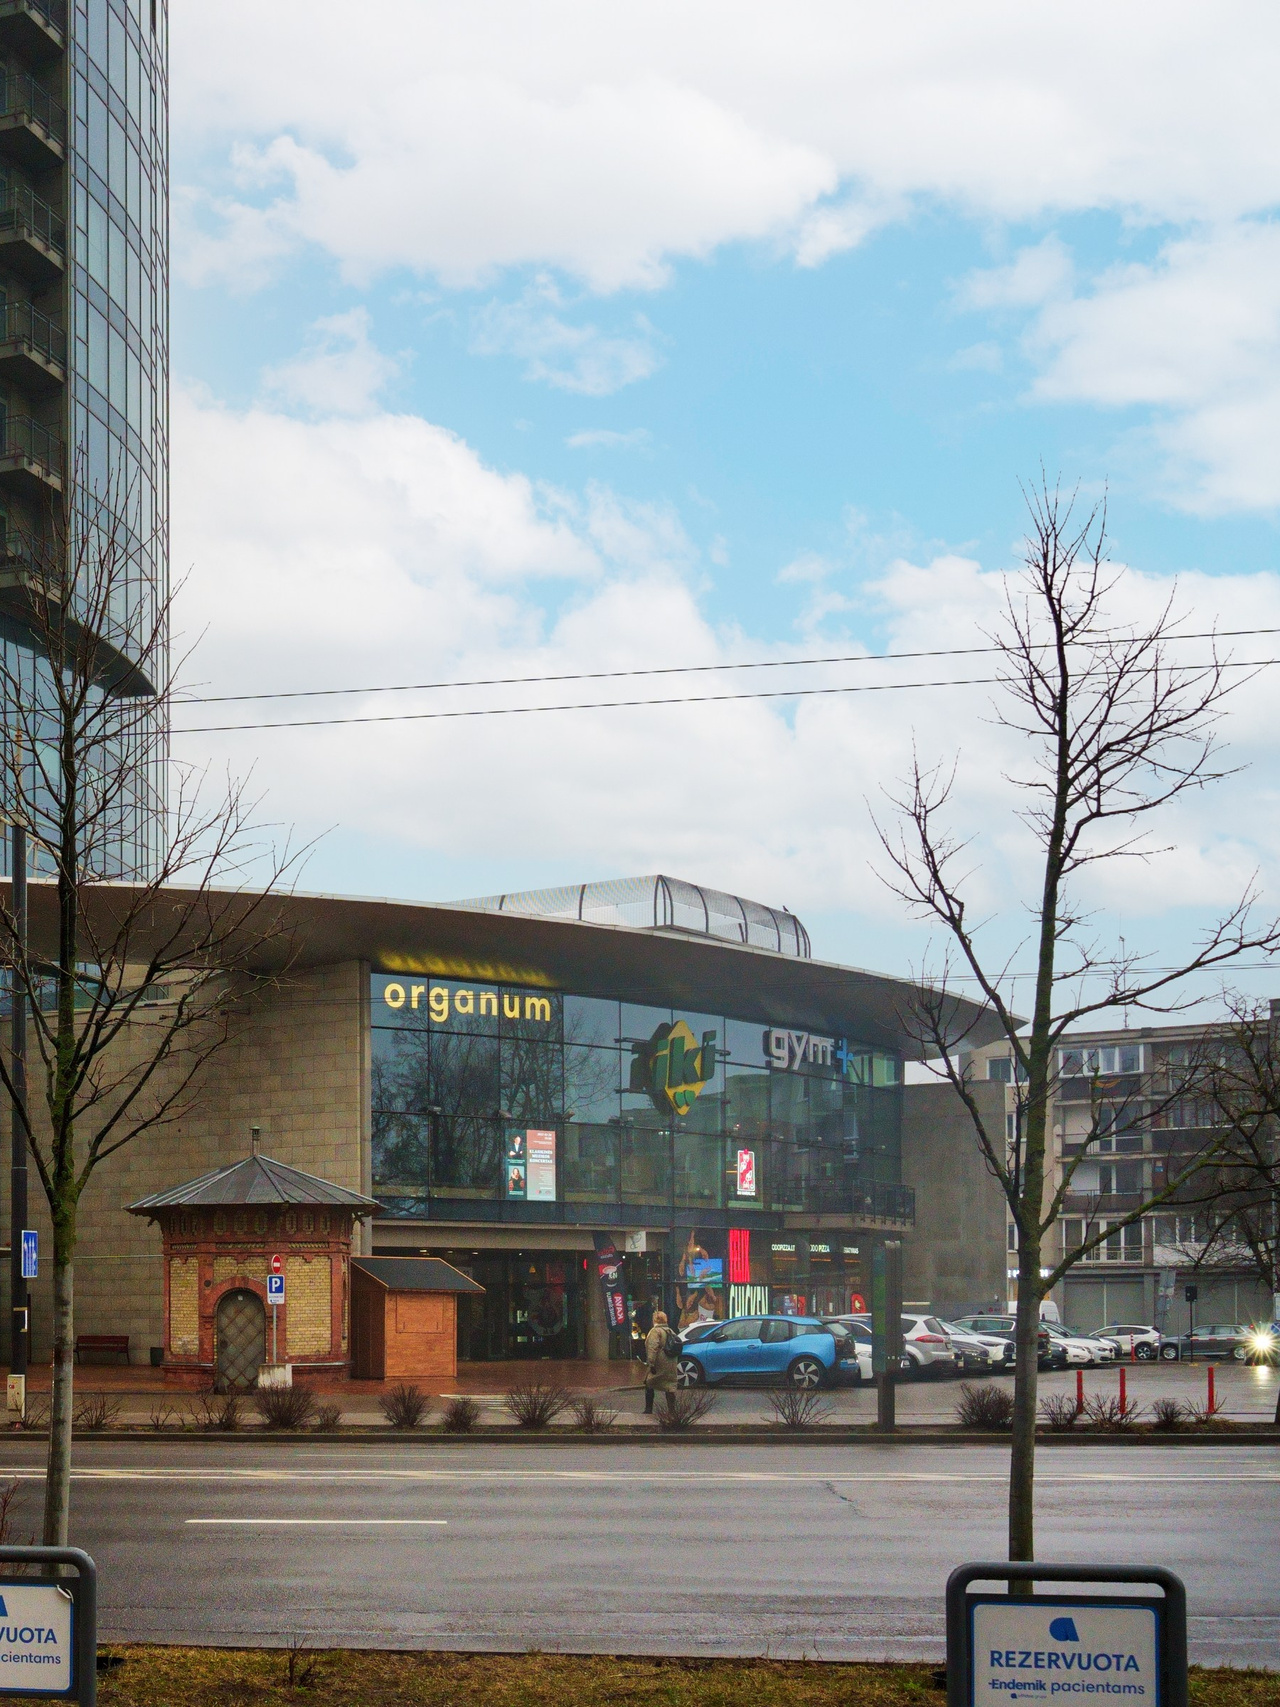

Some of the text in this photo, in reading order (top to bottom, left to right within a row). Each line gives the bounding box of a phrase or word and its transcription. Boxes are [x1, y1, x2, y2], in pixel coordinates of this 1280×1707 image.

[384, 983, 551, 1023] organum
[271, 1278, 281, 1292] P
[989, 1650, 1140, 1672] REZERVUOTA
[1050, 1680, 1146, 1695] pacientams
